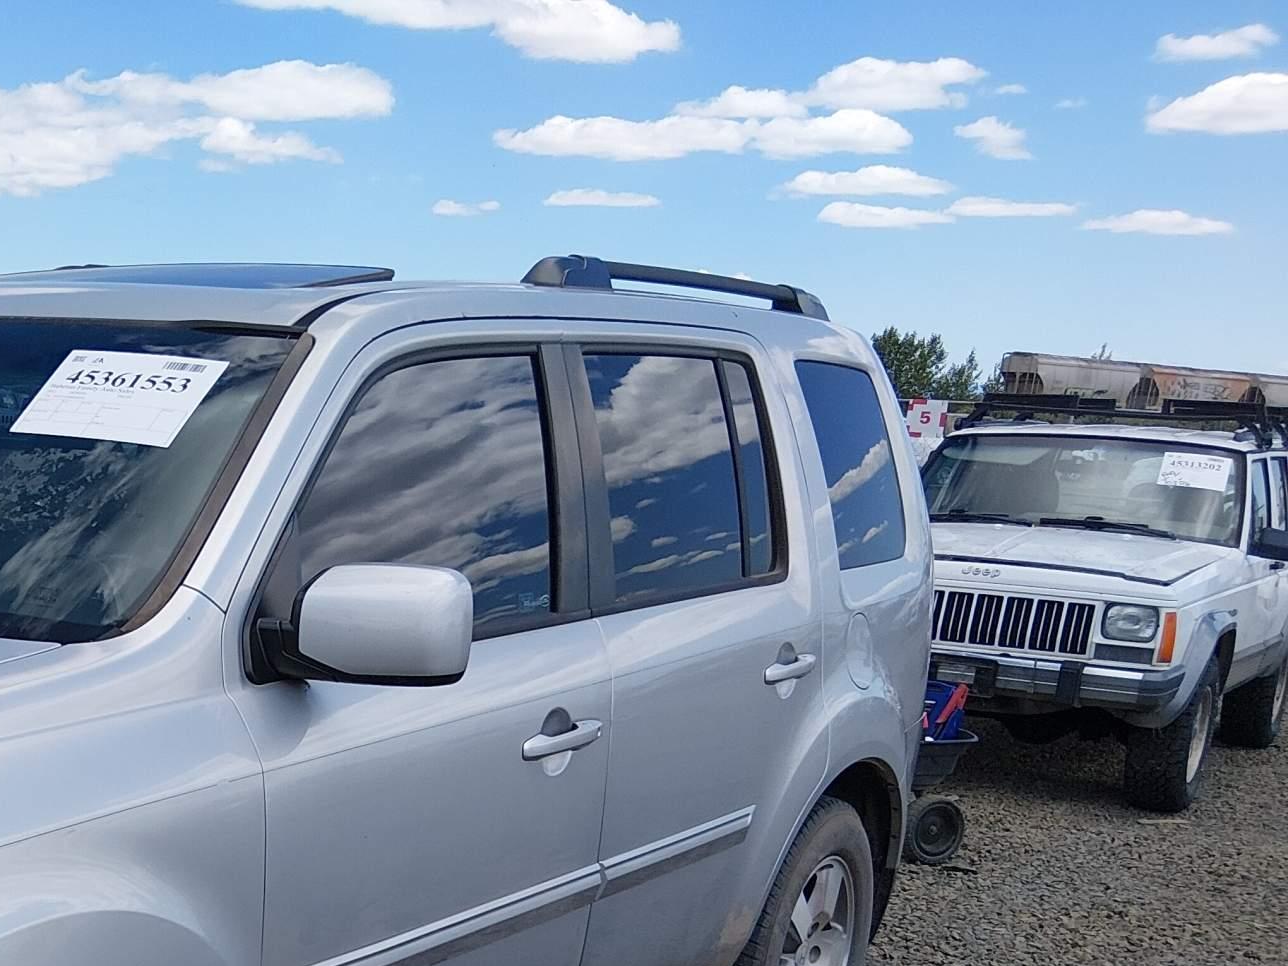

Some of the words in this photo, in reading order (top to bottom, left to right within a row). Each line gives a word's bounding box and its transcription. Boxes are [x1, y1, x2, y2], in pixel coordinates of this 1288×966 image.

[66, 369, 191, 393] 45361553
[919, 411, 931, 424] 5
[961, 566, 1000, 578] Jeep
